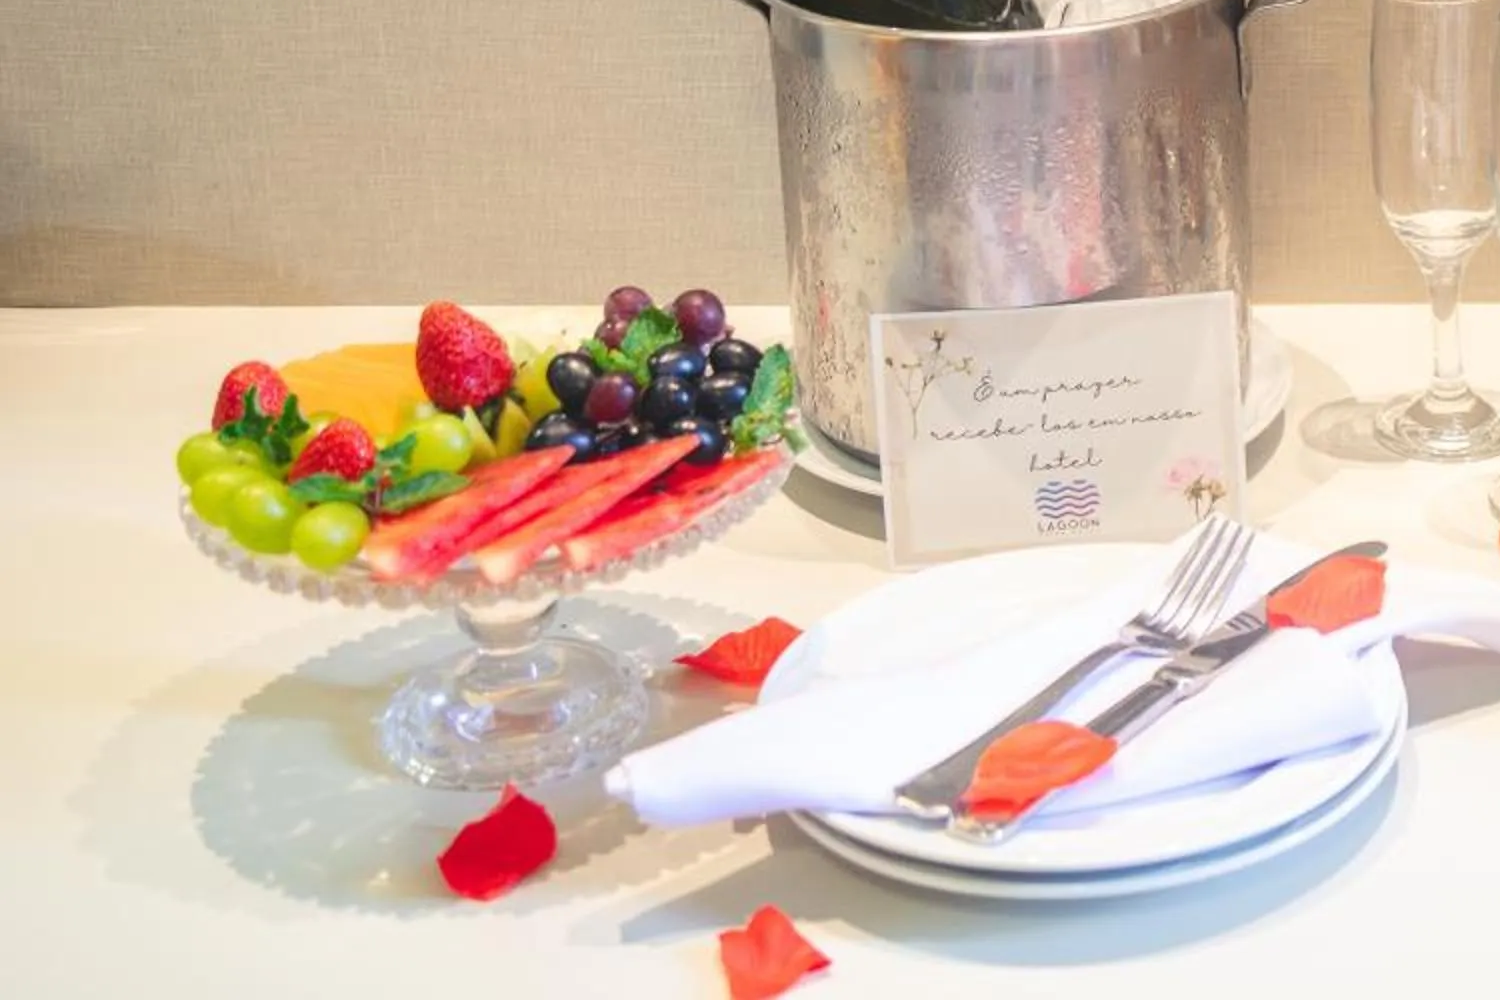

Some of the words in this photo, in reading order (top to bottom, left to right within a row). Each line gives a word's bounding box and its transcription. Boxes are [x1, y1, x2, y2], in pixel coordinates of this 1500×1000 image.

[1041, 376, 1142, 403] prazer
[1029, 448, 1103, 472] hotel
[1037, 519, 1100, 532] LAGOON
